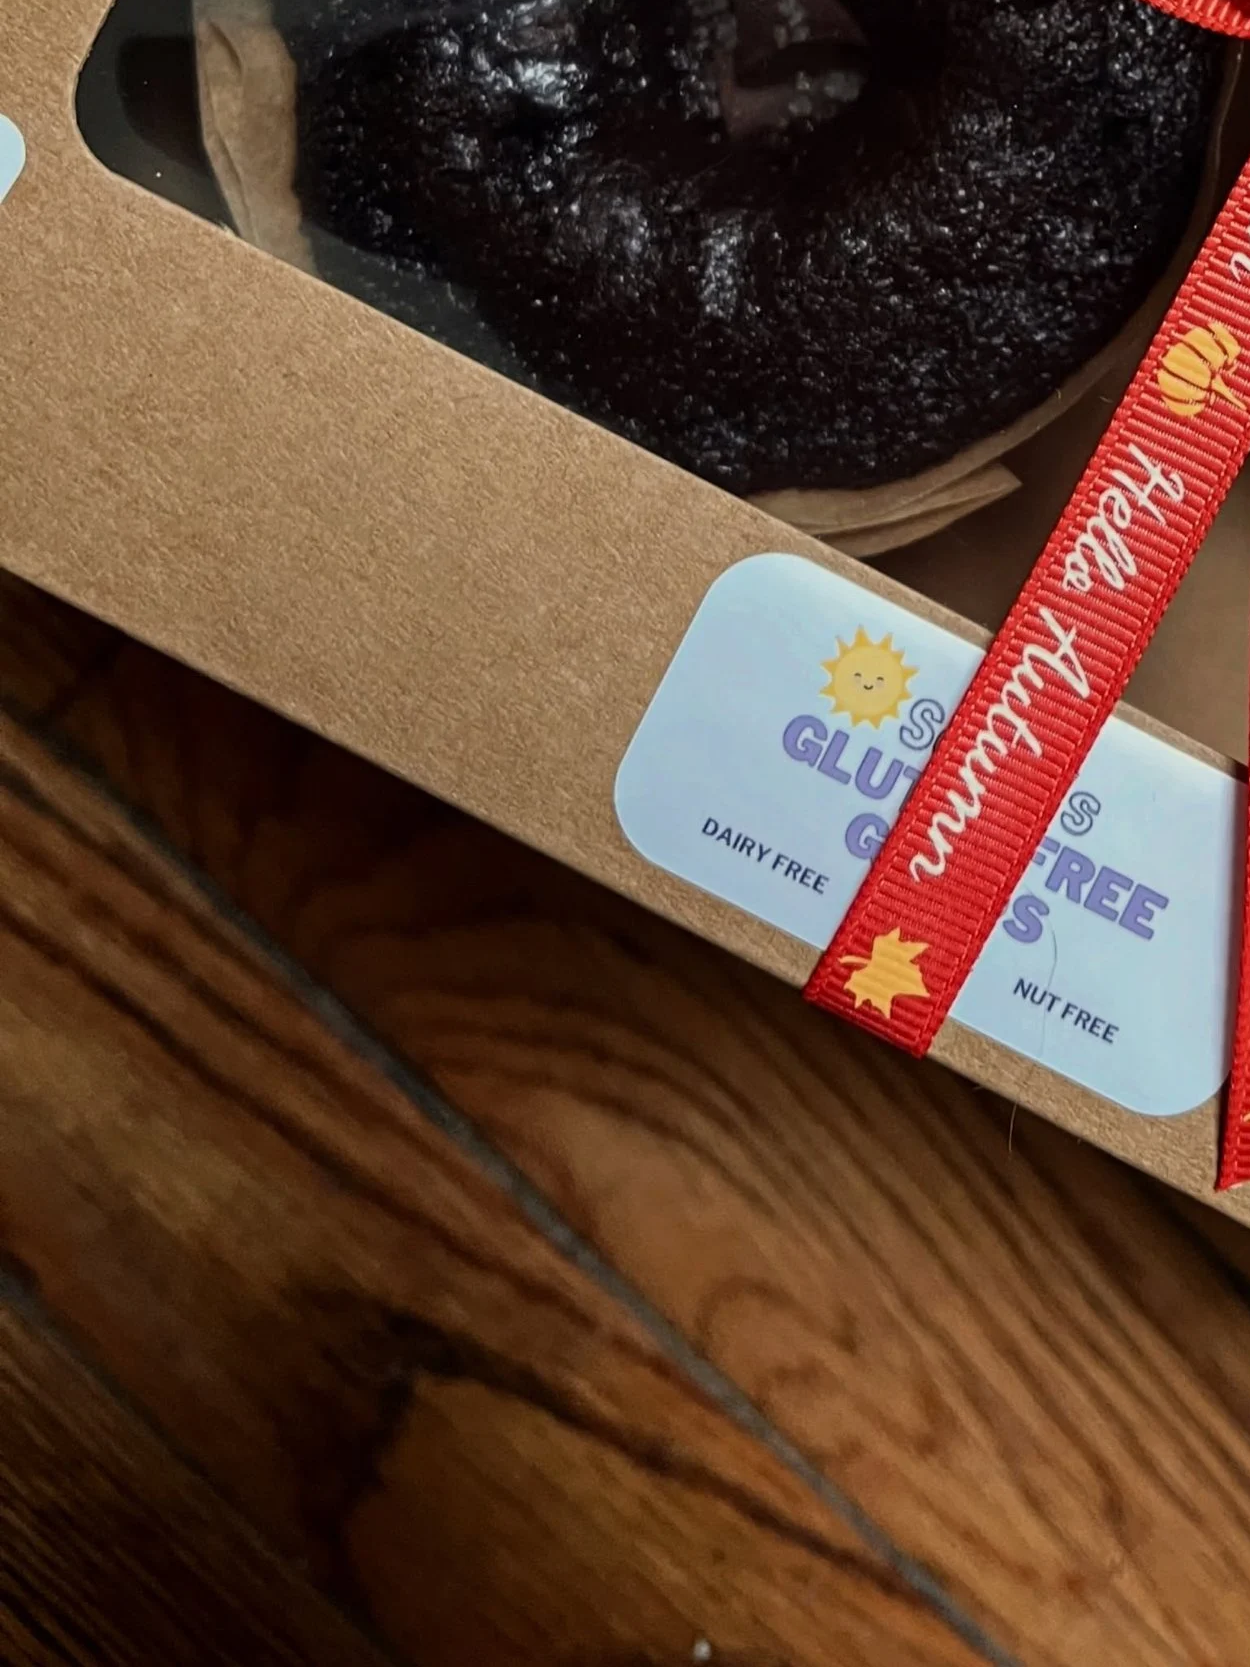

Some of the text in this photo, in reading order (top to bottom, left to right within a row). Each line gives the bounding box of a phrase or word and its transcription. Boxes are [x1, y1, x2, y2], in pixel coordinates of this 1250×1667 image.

[908, 443, 1185, 884] Hello Autumn
[701, 816, 830, 894] DAIRY FREE
[1013, 977, 1120, 1044] NUT FREE
